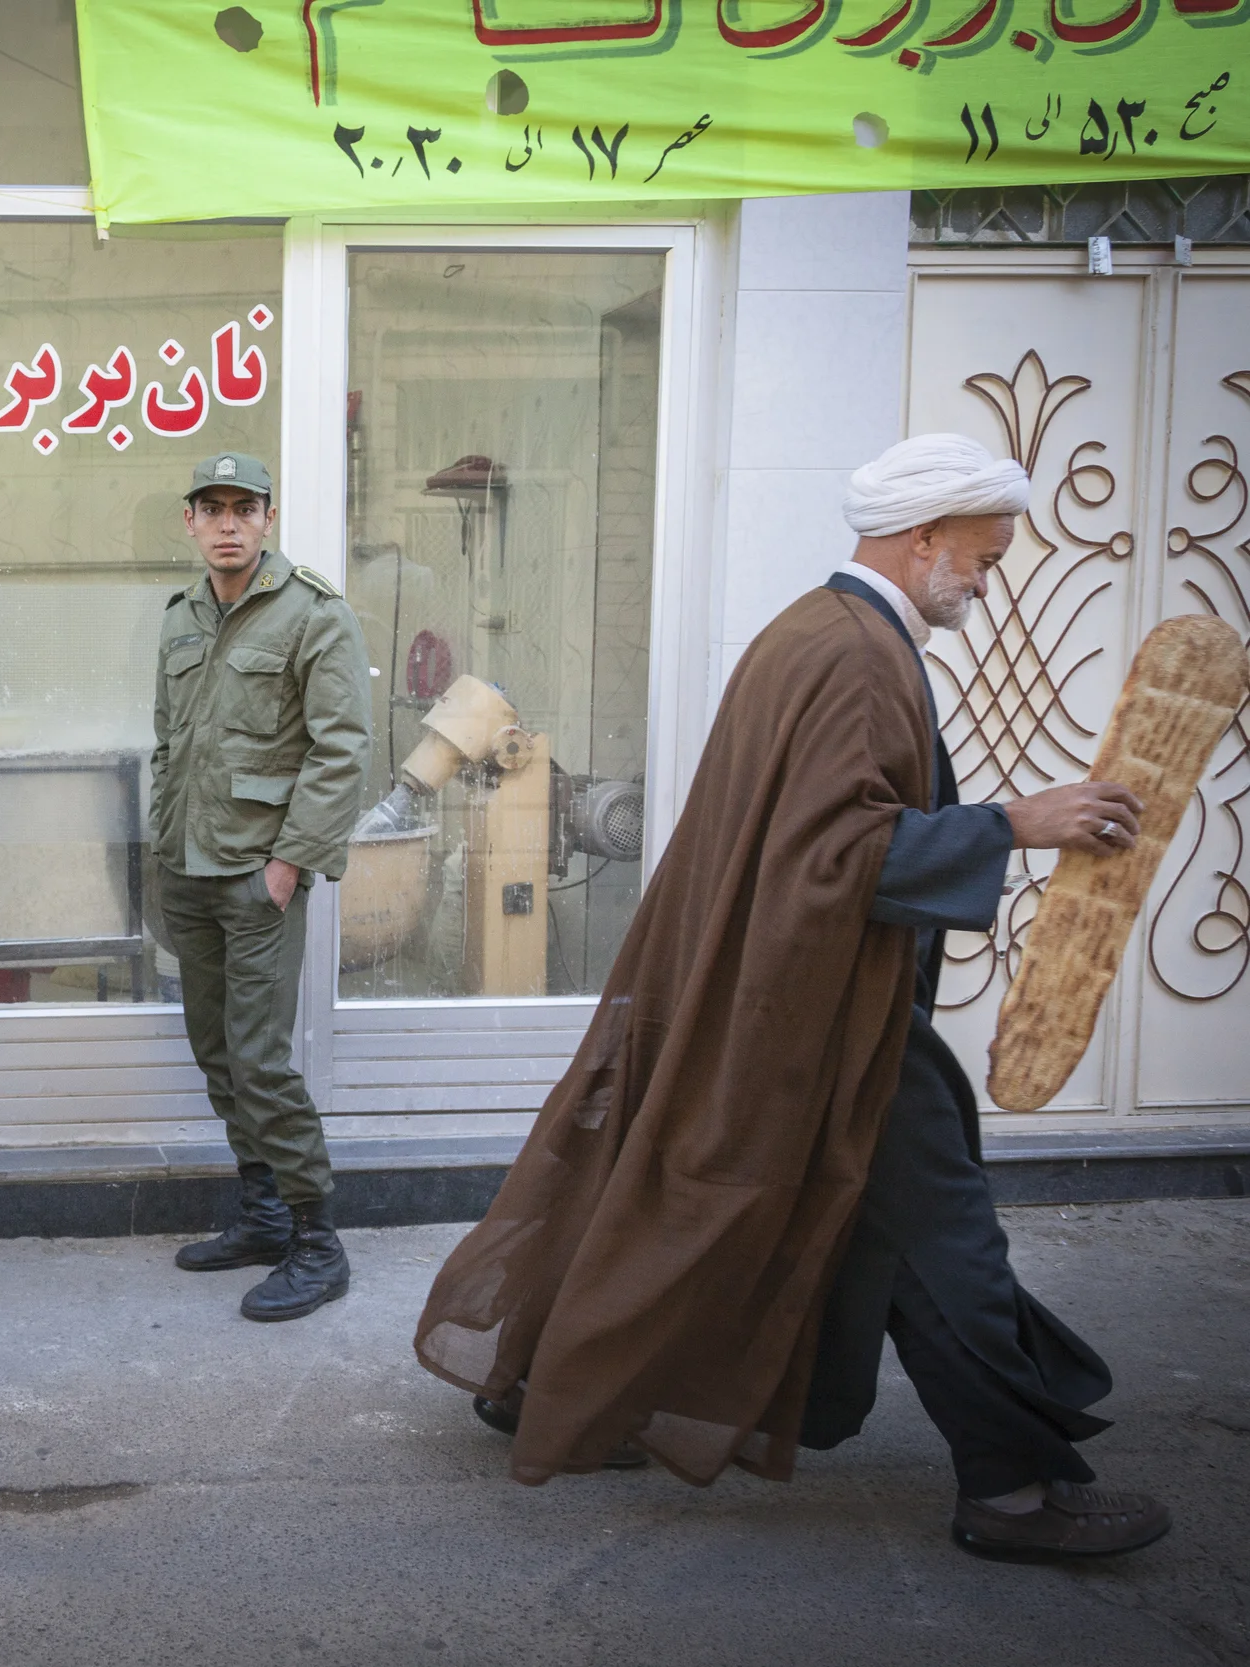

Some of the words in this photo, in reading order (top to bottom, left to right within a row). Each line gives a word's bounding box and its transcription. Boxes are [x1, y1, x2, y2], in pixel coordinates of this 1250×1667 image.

[960, 102, 999, 164] ۱۱
[1179, 71, 1231, 141] صبح
[571, 122, 630, 181] ۱۷
[642, 113, 714, 184] عصر
[143, 303, 273, 436] نان
